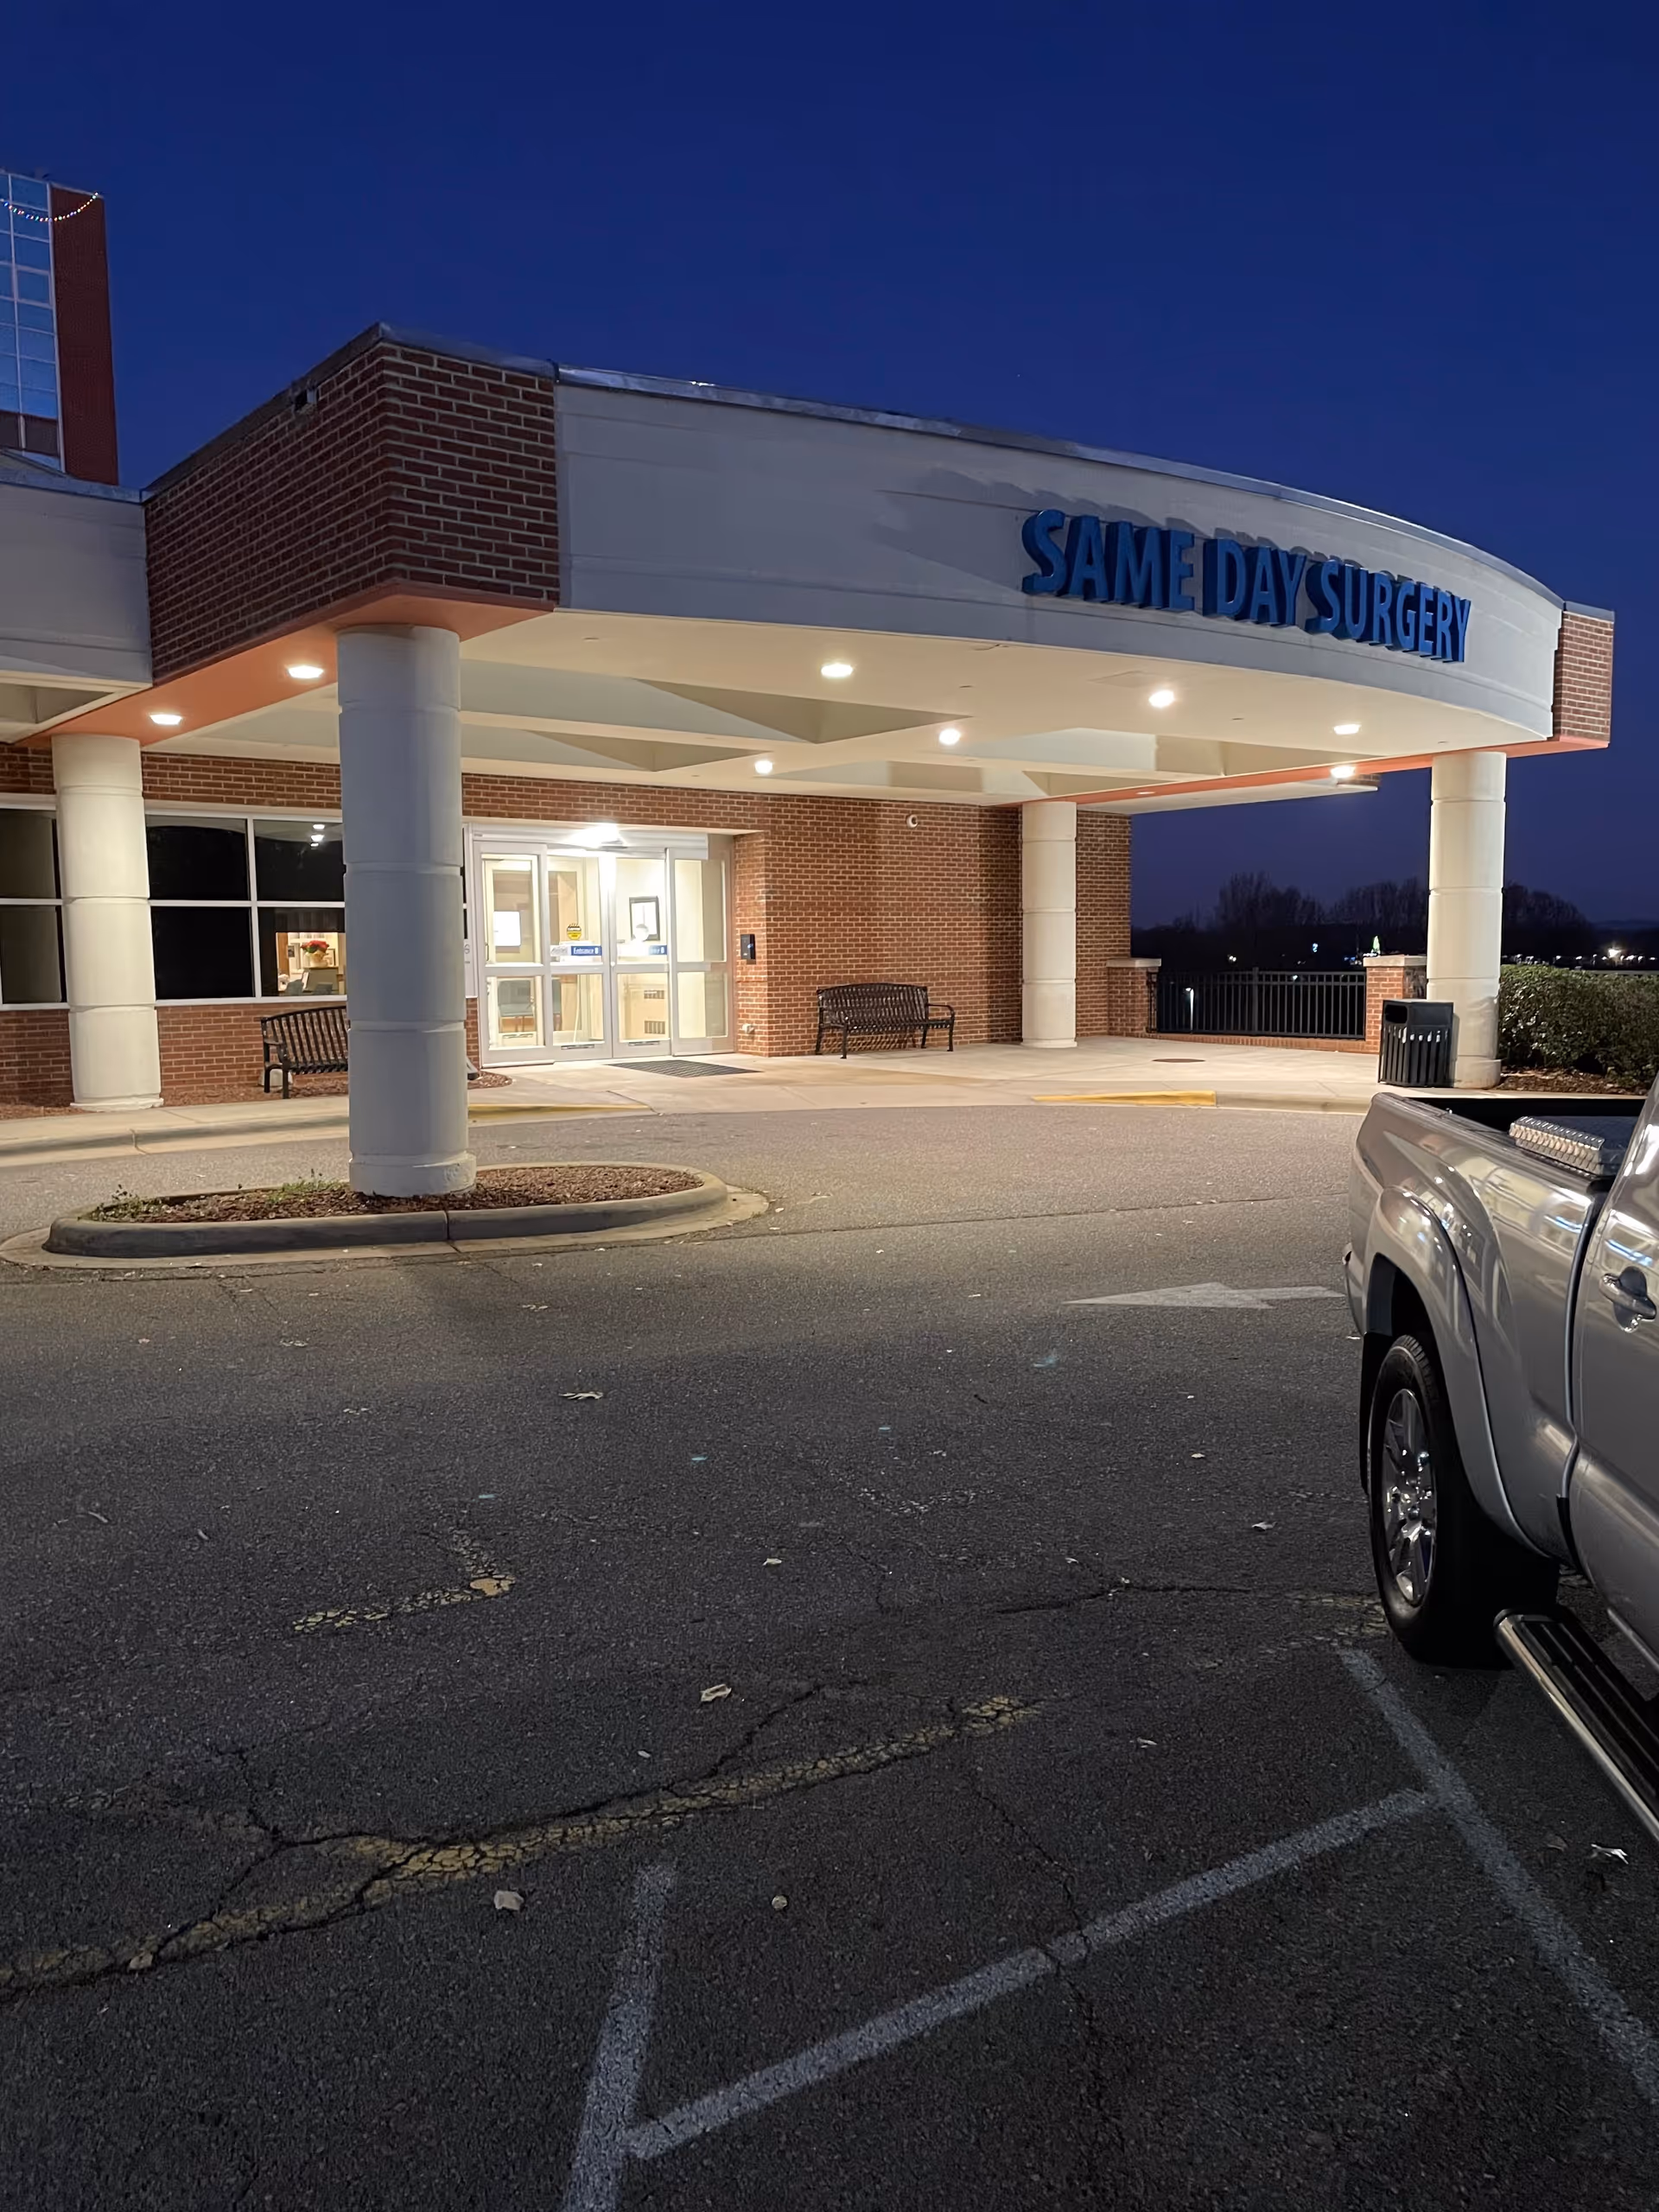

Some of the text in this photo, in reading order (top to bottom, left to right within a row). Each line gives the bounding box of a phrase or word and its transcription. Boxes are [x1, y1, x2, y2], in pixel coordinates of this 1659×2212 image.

[1022, 510, 1471, 663] SAME DAY SURGERY
